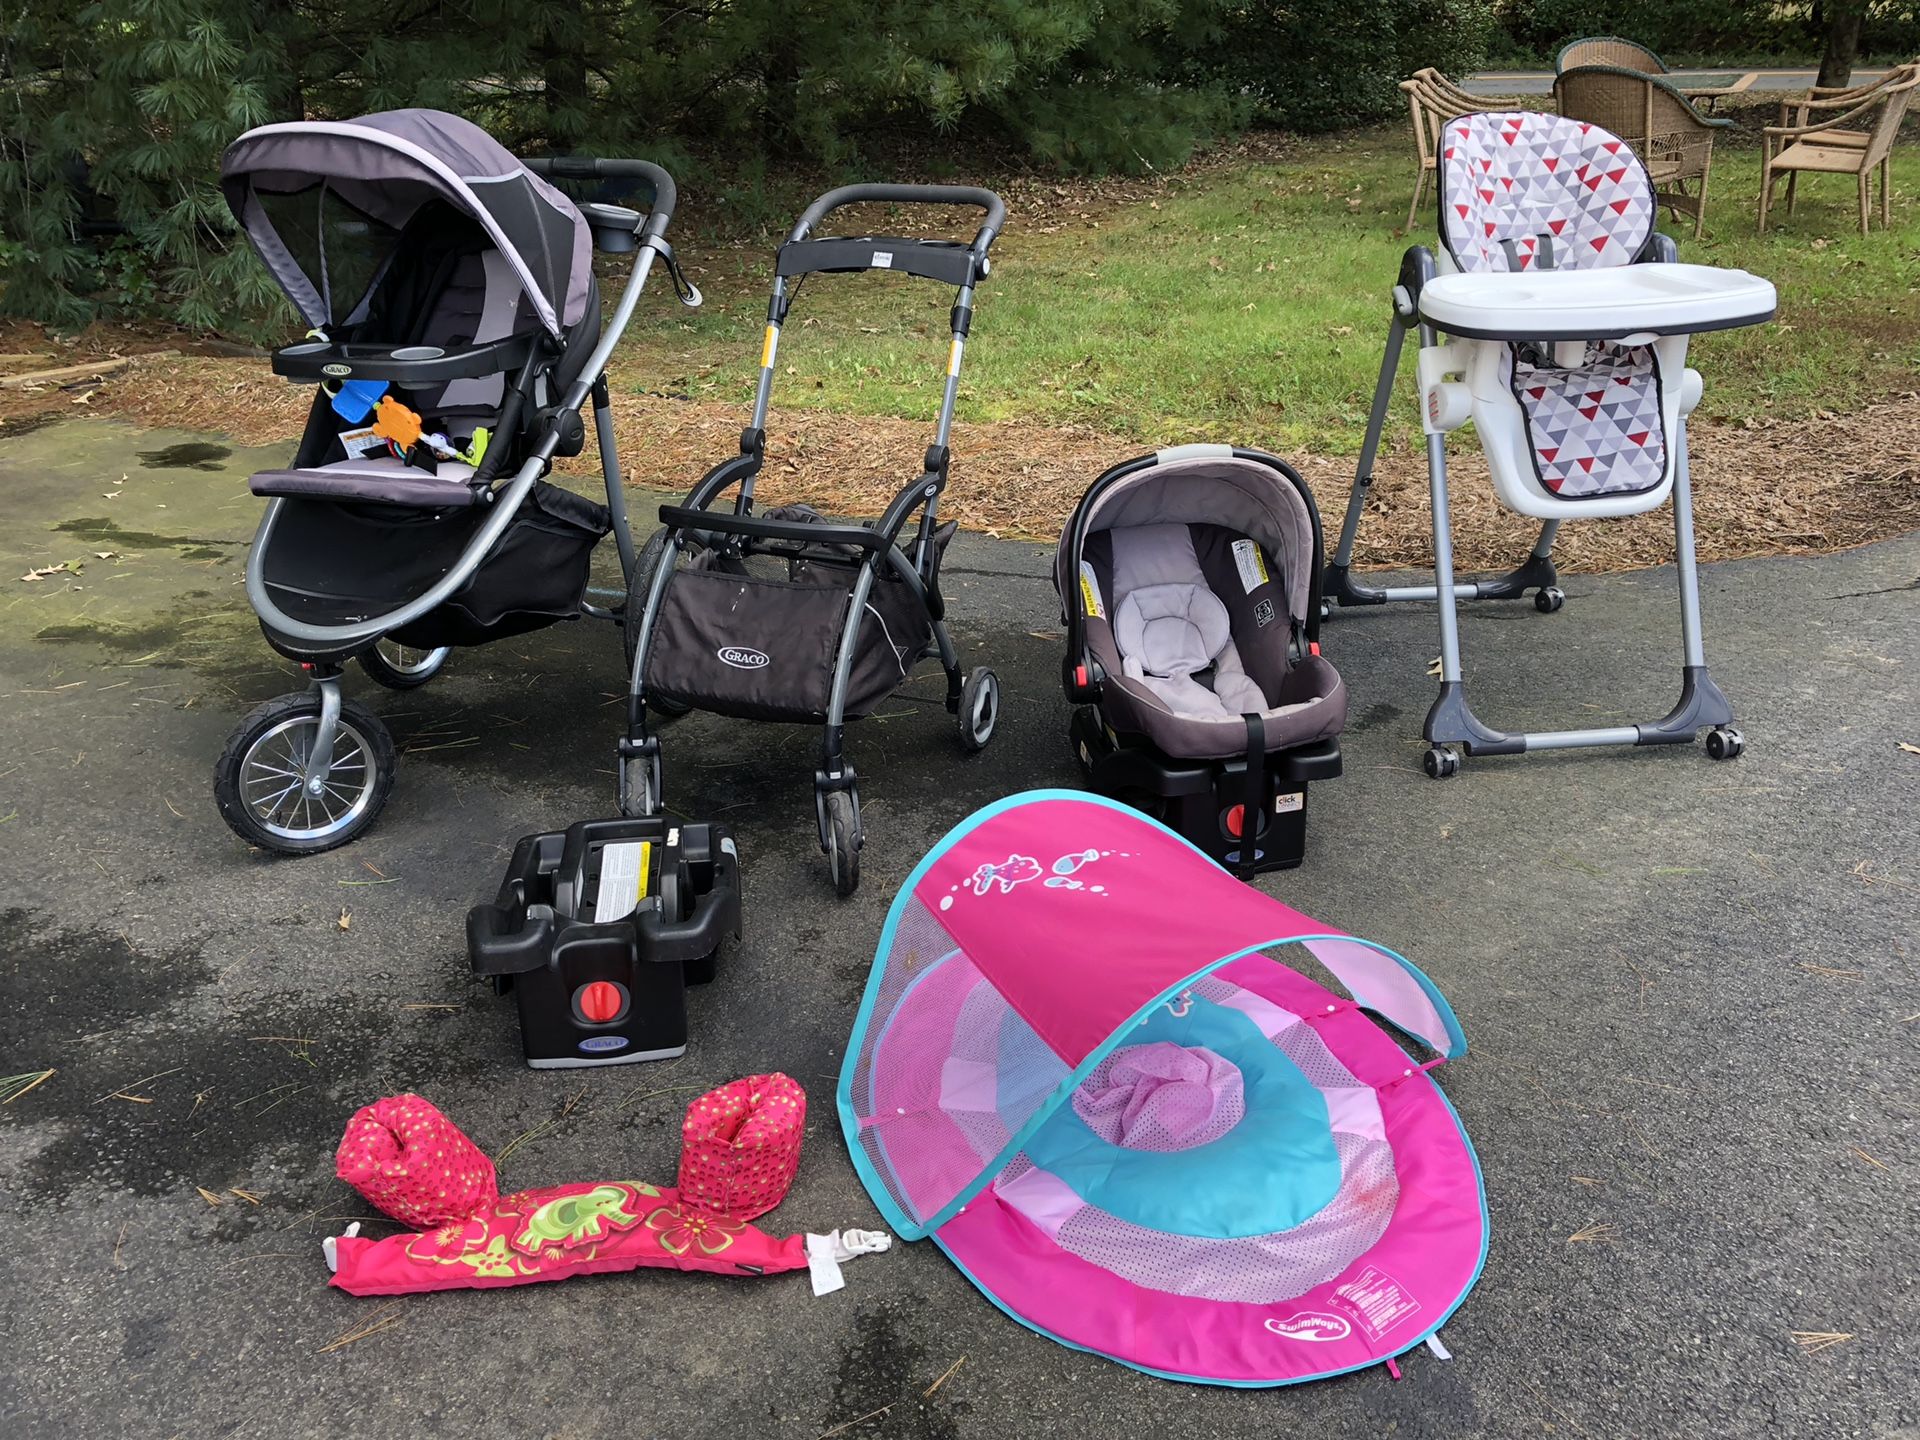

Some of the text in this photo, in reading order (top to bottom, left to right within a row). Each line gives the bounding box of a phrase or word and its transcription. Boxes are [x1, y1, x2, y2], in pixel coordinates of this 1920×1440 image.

[725, 649, 765, 665] GRACO
[1278, 795, 1296, 805] click
[1278, 1317, 1341, 1331] SwimWays
